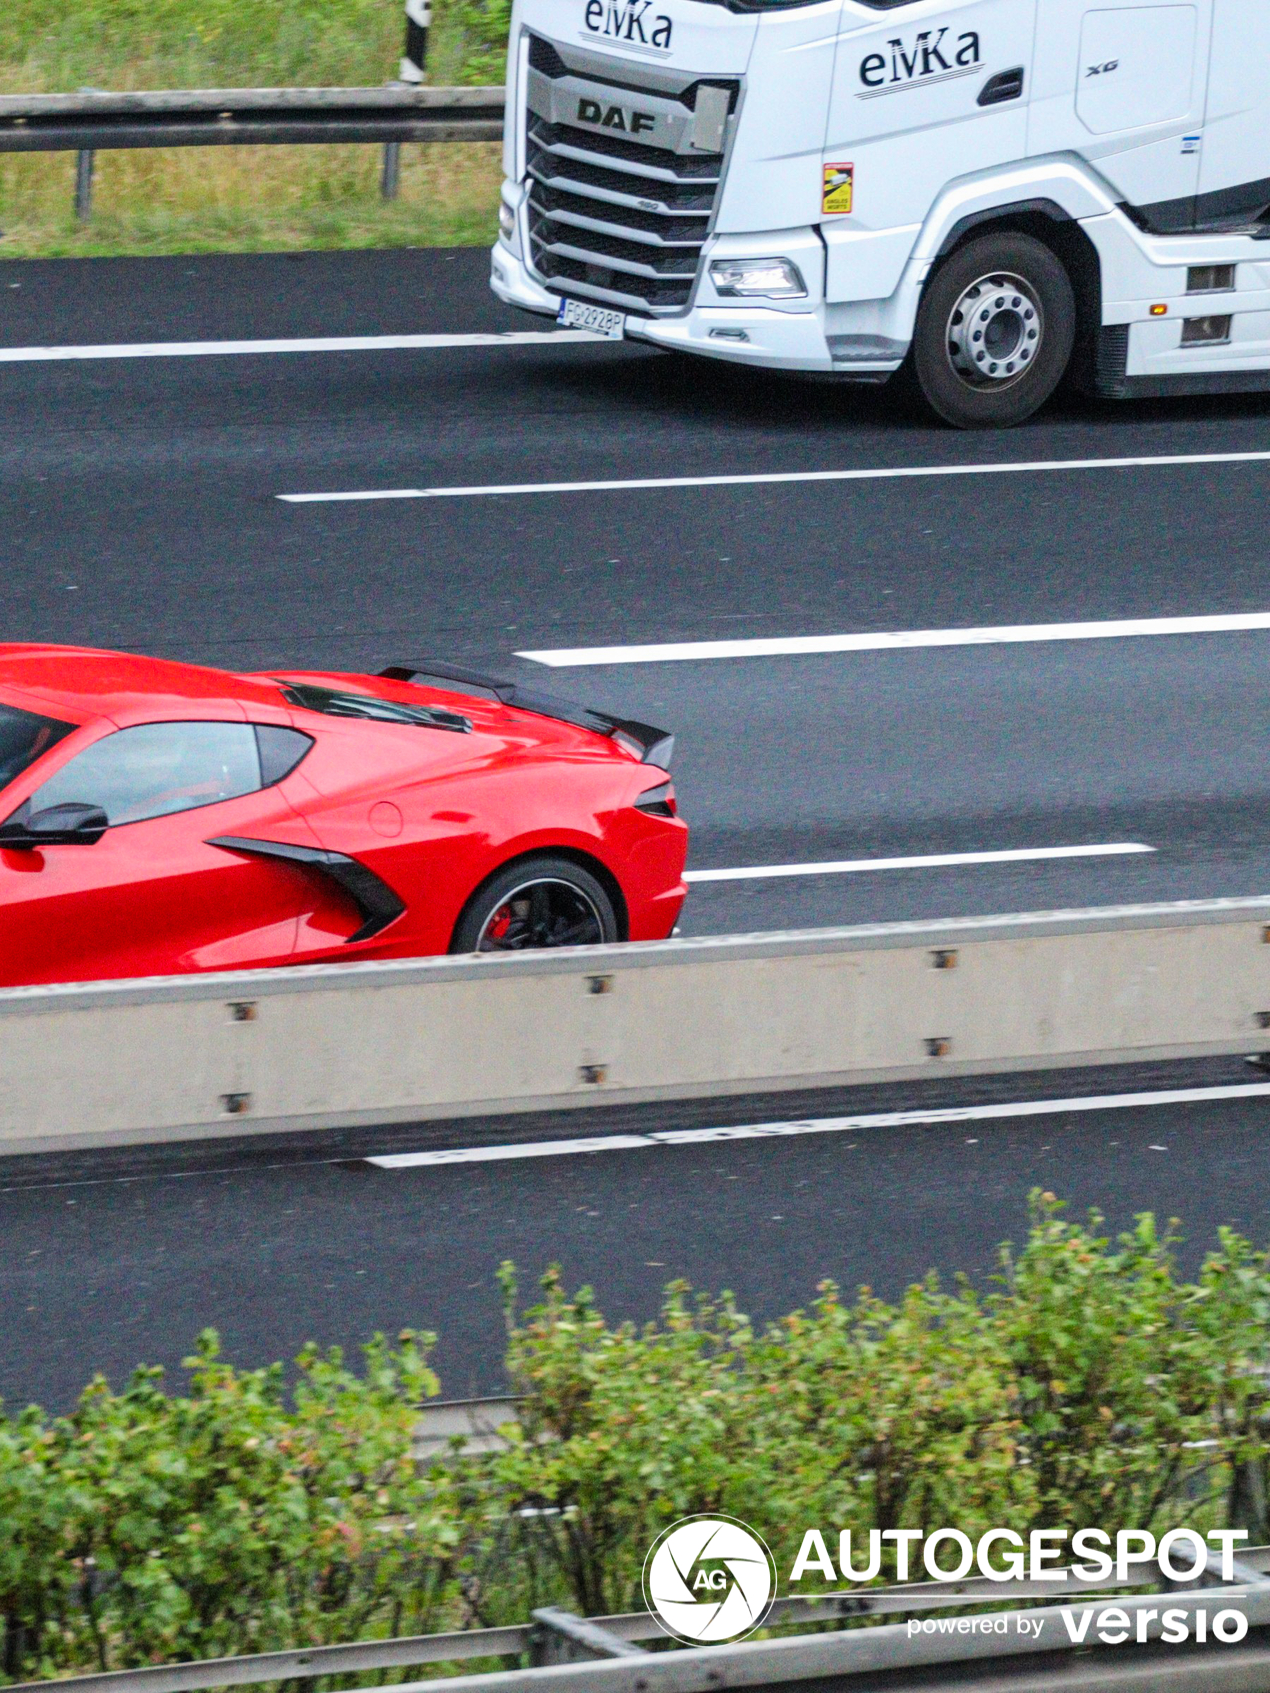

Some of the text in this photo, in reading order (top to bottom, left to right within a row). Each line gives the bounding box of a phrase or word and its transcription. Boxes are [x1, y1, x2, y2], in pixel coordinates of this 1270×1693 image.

[859, 27, 980, 87] eMKa
[1084, 58, 1119, 78] XG
[577, 98, 655, 133] DAF
